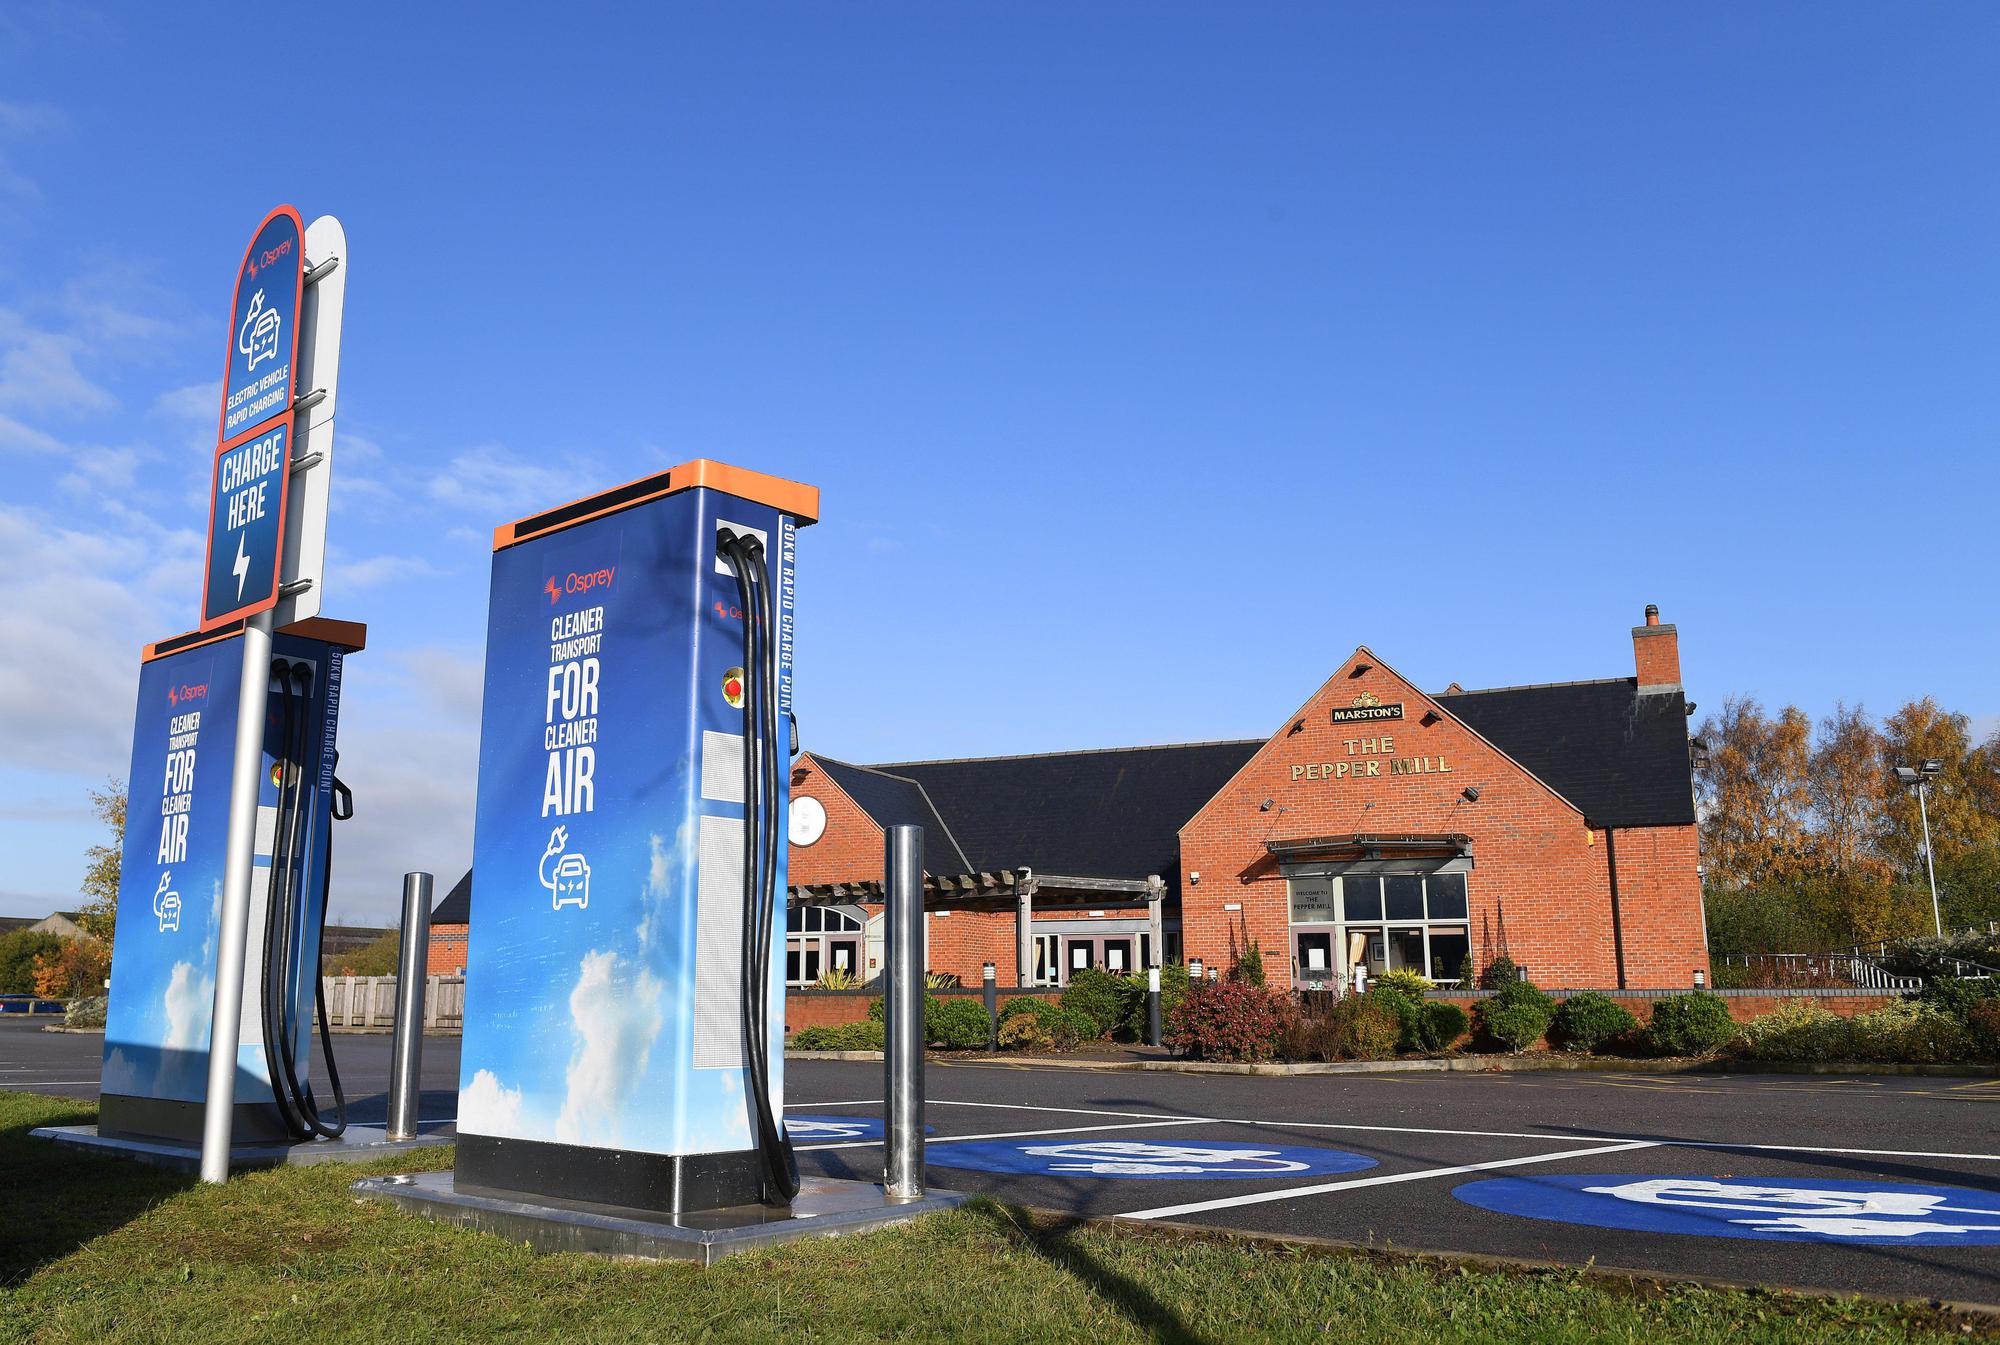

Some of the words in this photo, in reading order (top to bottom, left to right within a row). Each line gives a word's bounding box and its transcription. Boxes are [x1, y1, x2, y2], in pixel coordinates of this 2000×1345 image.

[260, 236, 292, 269] Osprey
[227, 379, 259, 410] ELECTRIC
[259, 364, 288, 395] VEHICLE
[227, 405, 248, 430] RAPID
[248, 387, 285, 418] CHARGING
[222, 433, 282, 493] CHARGE
[227, 480, 268, 531] HERE
[565, 566, 615, 594] Osprey
[782, 567, 794, 610] RAPID
[551, 606, 604, 642] CLEANER
[550, 633, 602, 663] TRANSPORT
[781, 614, 793, 670] CHARGE
[179, 683, 208, 702] Osprey
[327, 684, 340, 716] RAPID
[545, 657, 600, 724] FOR
[780, 675, 792, 718] POINT
[170, 711, 201, 736] CLEANER
[1334, 706, 1401, 721] MARSTON'S
[169, 731, 199, 751] TRANSPORT
[323, 719, 336, 760] CHARGE
[544, 717, 598, 751] CLEANER
[1343, 736, 1395, 756] THE
[163, 749, 196, 796] FOR
[320, 762, 333, 795] POINT
[541, 746, 595, 818] AIR
[1290, 760, 1381, 781] PEPPER
[1390, 756, 1453, 776] MILL
[161, 793, 191, 816] CLEANER
[157, 814, 189, 865] AIR
